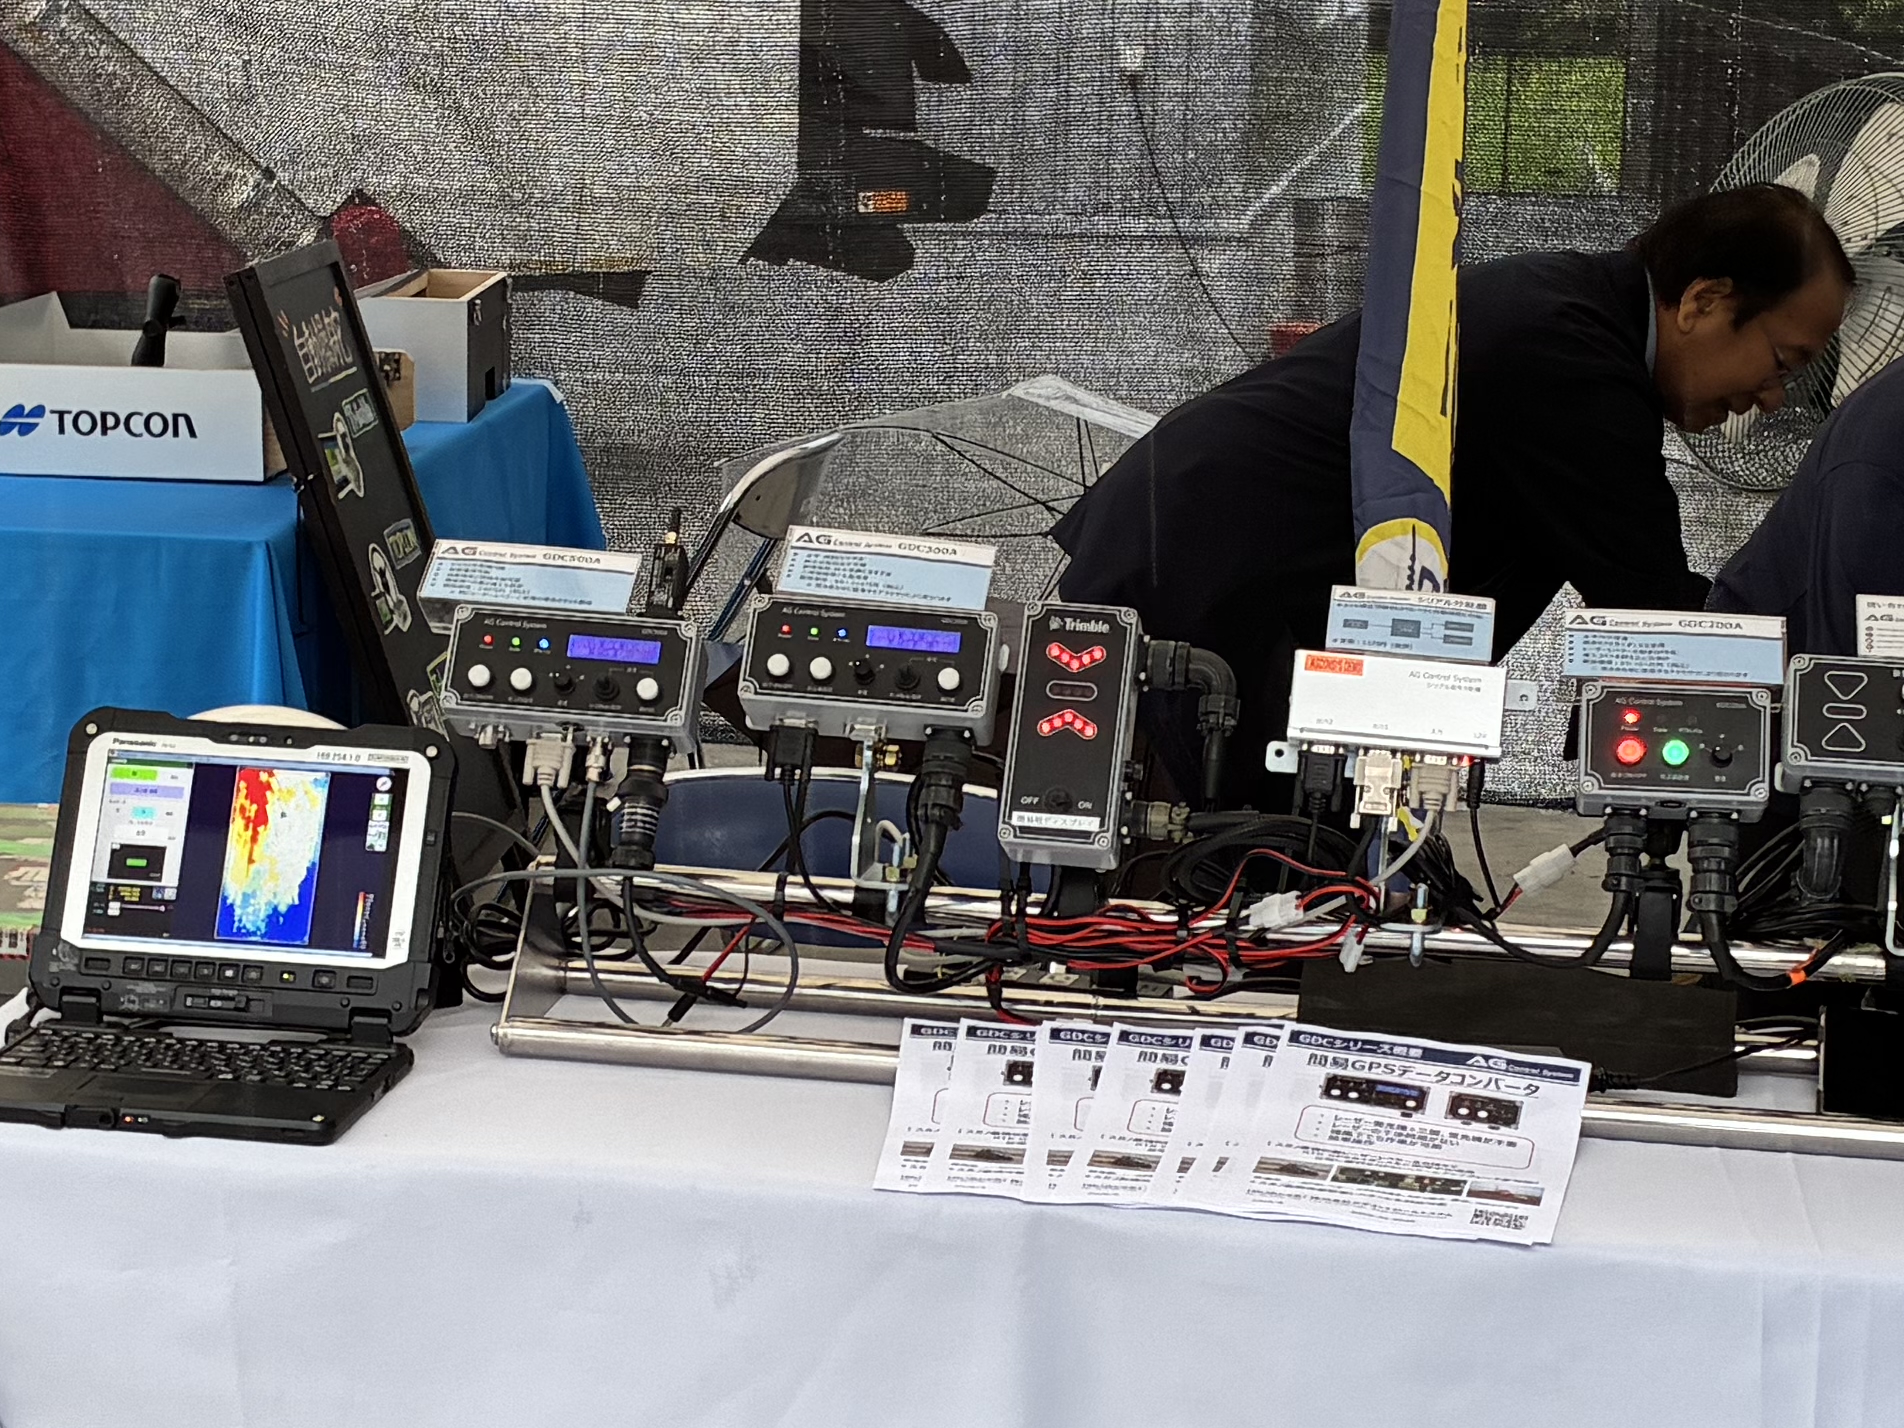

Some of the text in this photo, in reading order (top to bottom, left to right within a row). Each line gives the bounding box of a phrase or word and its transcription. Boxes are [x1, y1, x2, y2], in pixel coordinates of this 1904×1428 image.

[50, 404, 199, 440] TOPCON
[795, 532, 833, 545] AG
[1063, 617, 1110, 634] Trimble
[1569, 614, 1607, 626] AG
[112, 737, 158, 748] Panasonic
[1020, 795, 1040, 806] OFF
[1078, 799, 1093, 810] ON
[1465, 1054, 1509, 1070] AG
